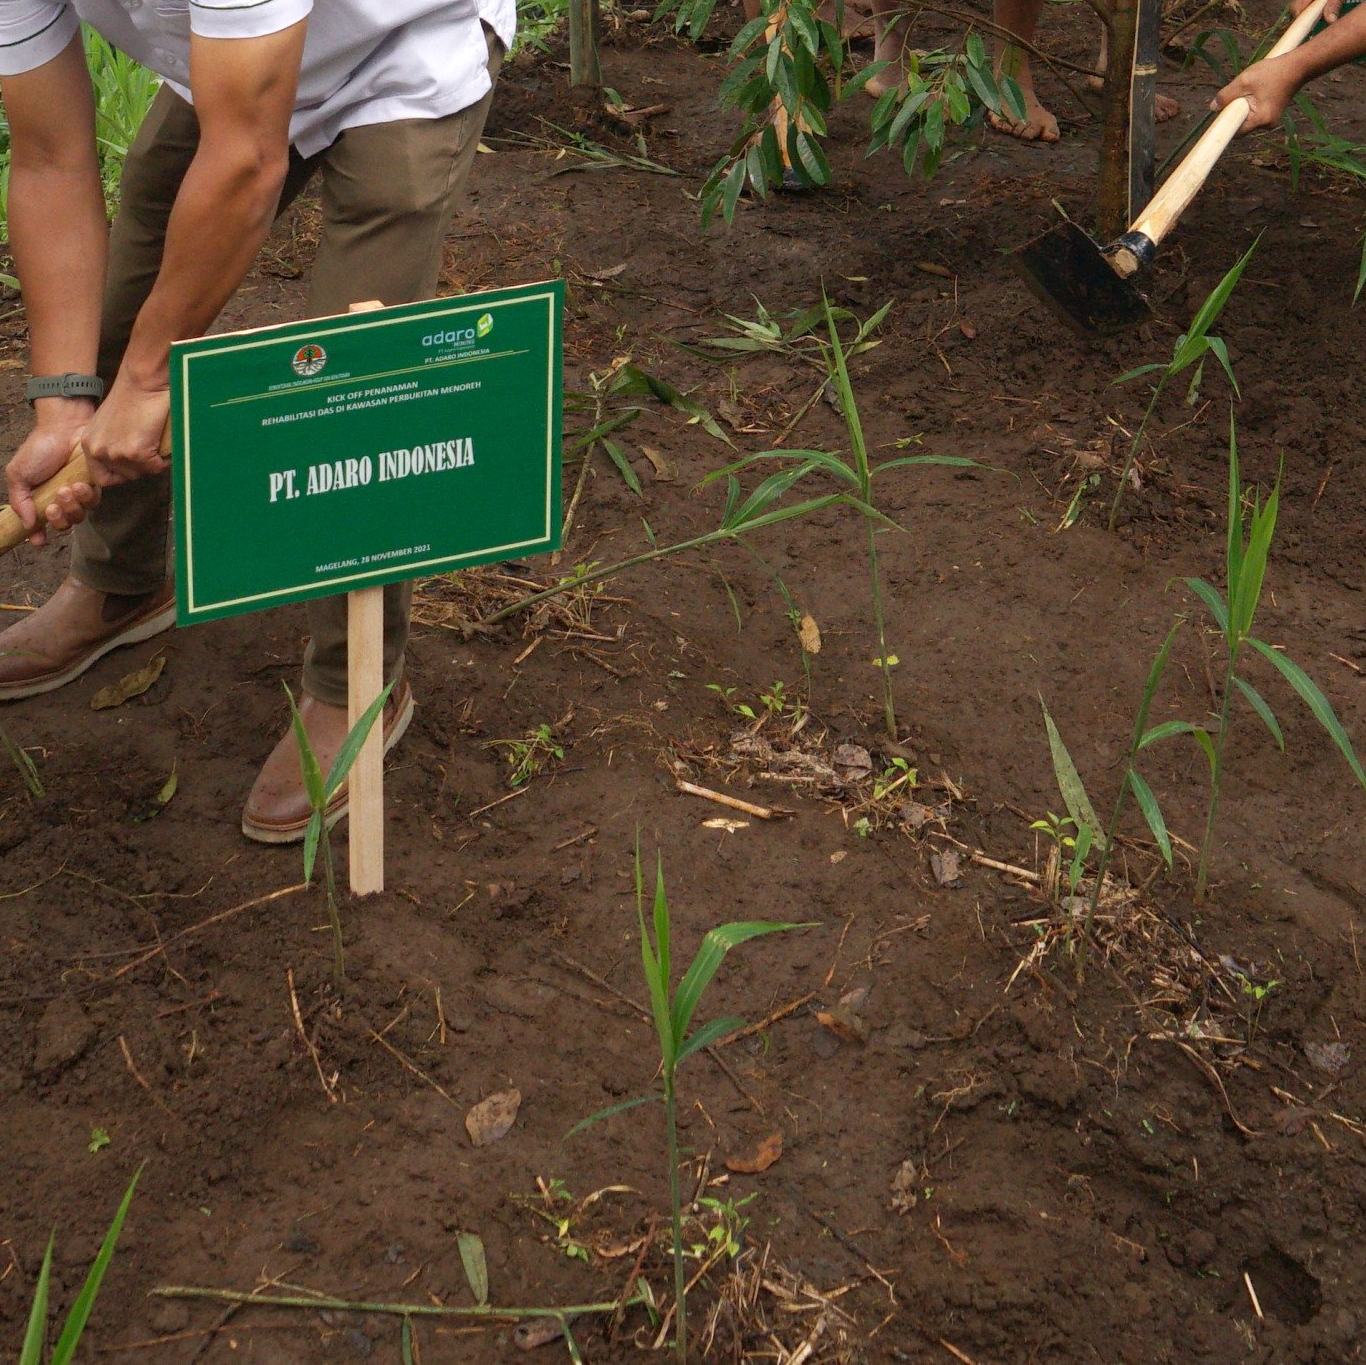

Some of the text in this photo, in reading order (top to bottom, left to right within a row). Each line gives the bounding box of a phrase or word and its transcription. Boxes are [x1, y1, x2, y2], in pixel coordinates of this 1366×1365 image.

[421, 327, 476, 347] adaro
[262, 381, 482, 426] REHABILITASI DAS DI KAWASAN PERBUKITAN MENOREH
[327, 381, 419, 404] KICK OFF PENANAMAN
[269, 437, 475, 502] PT. ADARO INDONESIA
[315, 558, 360, 573] MAGELANG,
[371, 547, 413, 562] NOVEMBER
[413, 544, 431, 554] 2021
